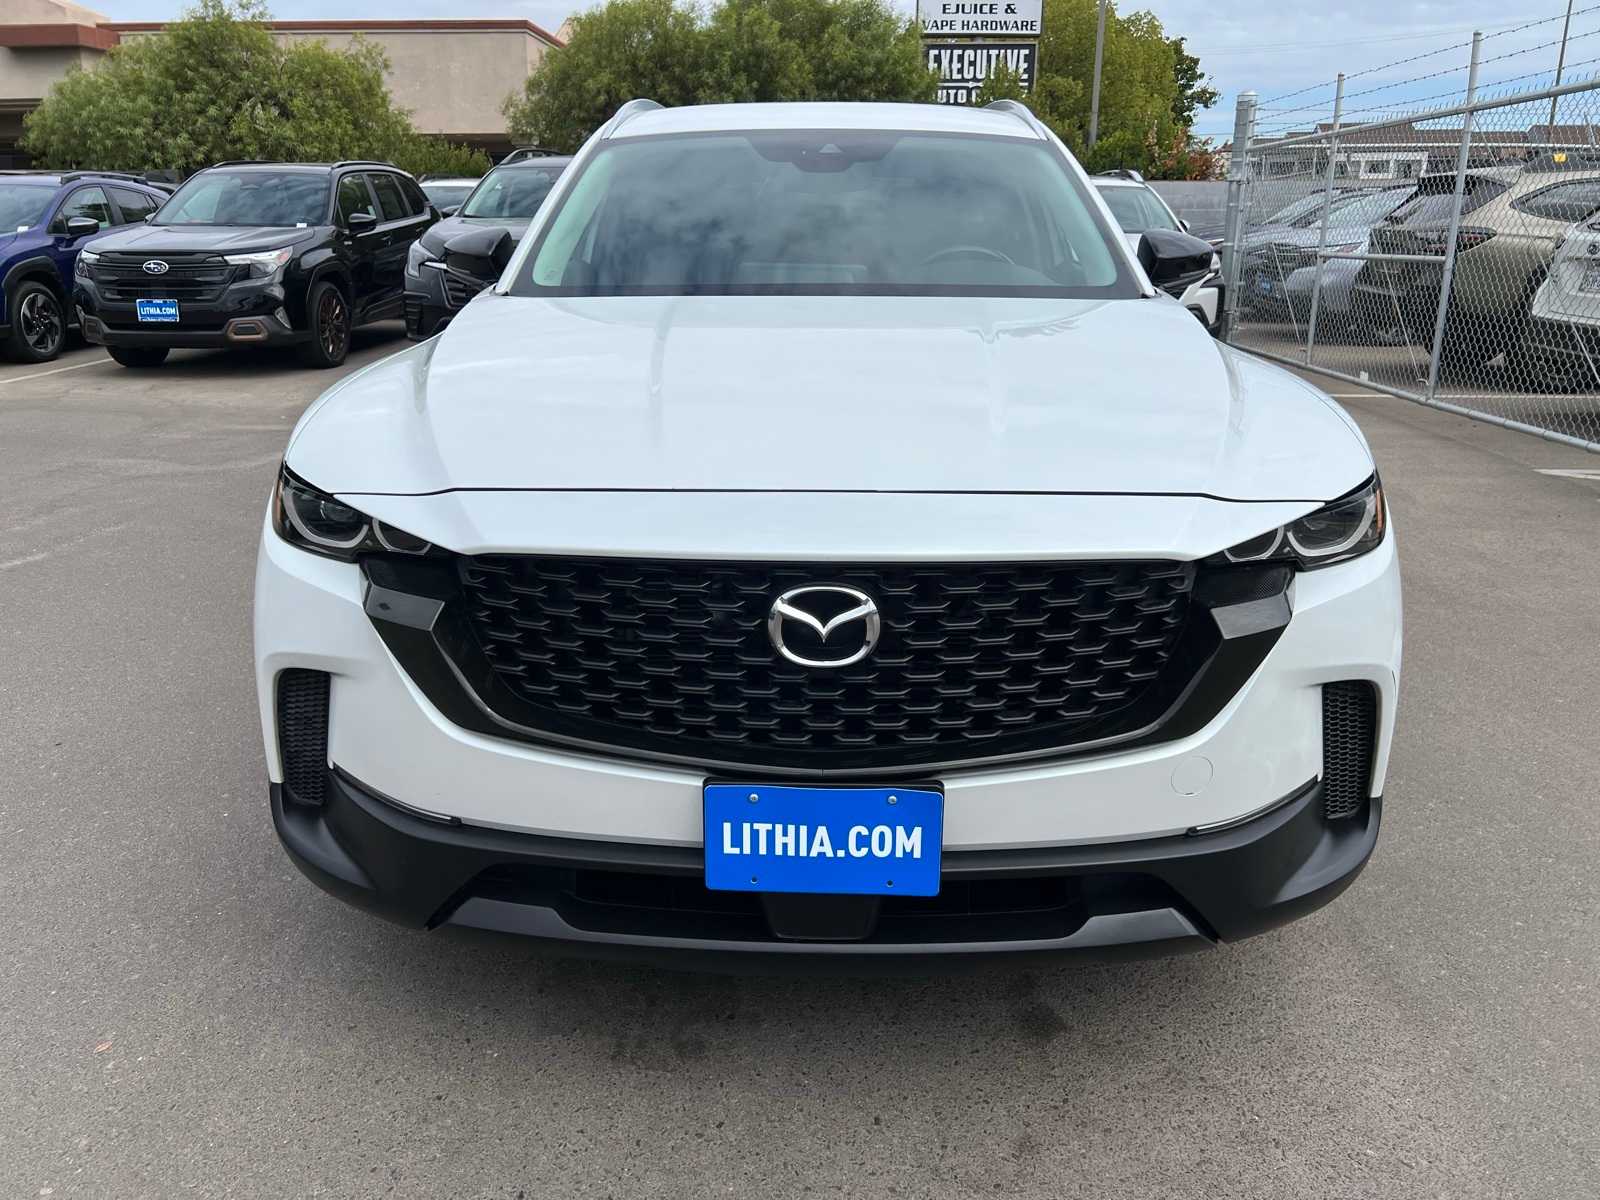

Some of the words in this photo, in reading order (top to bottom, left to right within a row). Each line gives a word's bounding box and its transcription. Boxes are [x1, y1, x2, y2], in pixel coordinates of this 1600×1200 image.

[942, 4, 998, 14] EJUICE
[1004, 3, 1017, 14] &
[922, 20, 956, 31] VAPE
[961, 20, 1037, 31] HARDWARE
[931, 89, 967, 104] UTO
[140, 306, 176, 315] LITHIA.COM
[722, 822, 922, 859] LITHIA.COM
